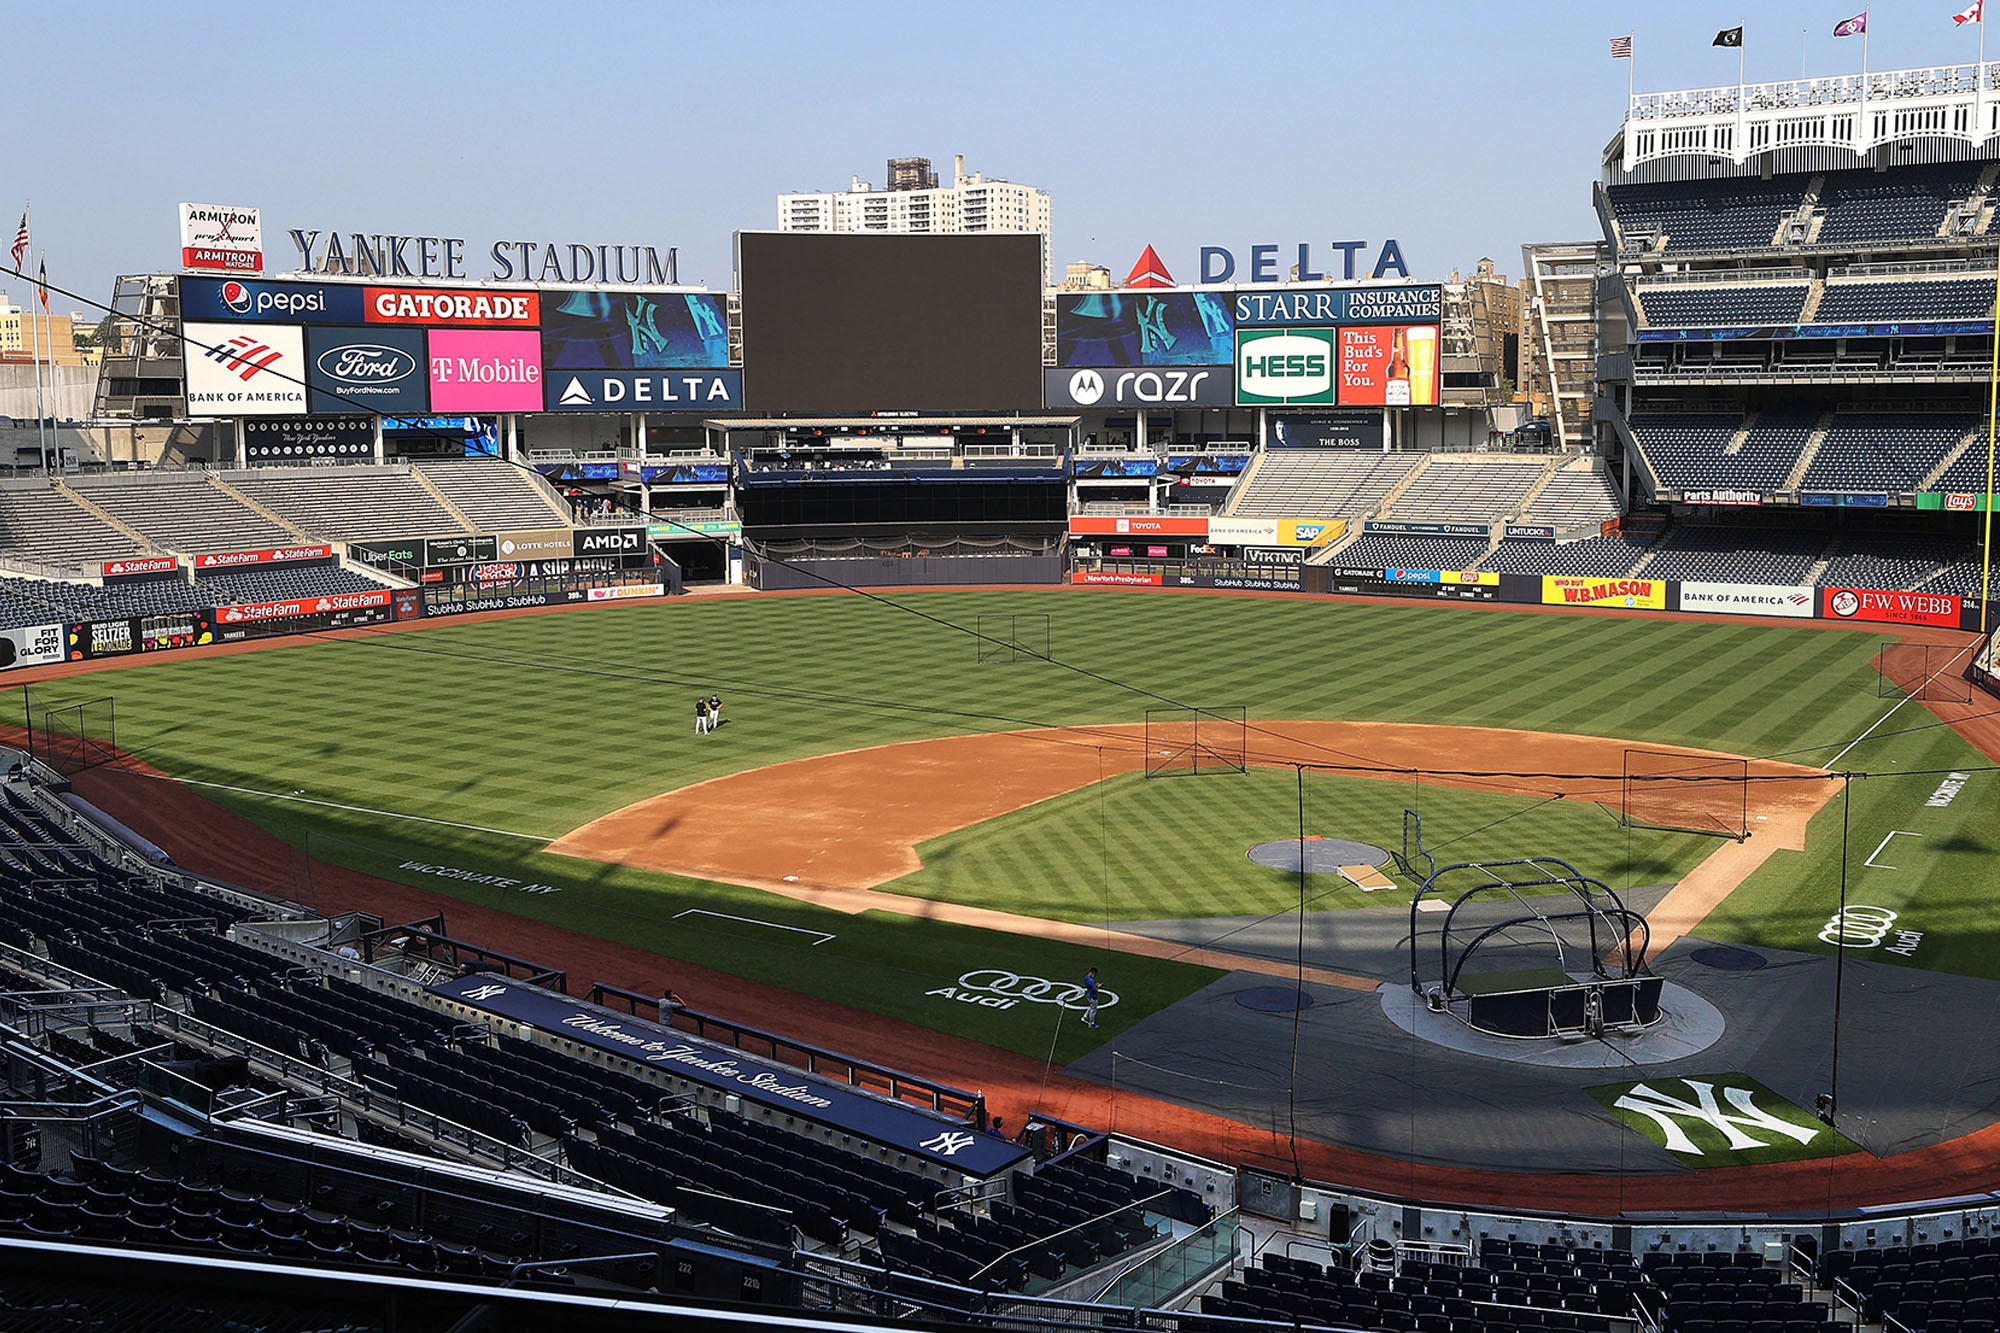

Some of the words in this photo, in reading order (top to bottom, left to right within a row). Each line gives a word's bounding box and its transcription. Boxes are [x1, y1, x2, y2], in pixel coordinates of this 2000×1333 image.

[189, 210, 256, 225] ARMITRON
[195, 251, 255, 262] ARMITRON
[288, 228, 467, 279] YANKEE
[491, 240, 680, 285] STADIUM
[1200, 239, 1409, 285] DELTA
[257, 289, 326, 315] pepsi
[1349, 289, 1440, 305] INSURANCE
[375, 293, 530, 319] GATORADE
[1236, 294, 1338, 321] STARR
[1348, 303, 1440, 319] COMPANIES
[1343, 331, 1377, 344] This
[1344, 345, 1383, 358] Bud's
[334, 349, 399, 378] Ford
[457, 357, 540, 383] Mobile
[1246, 355, 1325, 377] HESS
[1343, 359, 1369, 372] For
[1343, 373, 1375, 386] You.
[336, 386, 401, 395] BuyFordNow.com
[603, 377, 731, 402] DELTA
[1116, 371, 1209, 402] razr
[189, 392, 225, 402] BANK
[227, 392, 244, 402] OF
[247, 392, 303, 402] AMERICA
[1319, 438, 1336, 446] THE
[1338, 438, 1360, 446] BOSS
[1684, 490, 1711, 500] Parts
[1712, 489, 1761, 502] Authority
[1296, 527, 1318, 538] SAP
[1379, 523, 1407, 531] FANDUEL
[1451, 525, 1480, 533] FANDUEL
[583, 535, 623, 550] AMD
[1190, 544, 1216, 554] FedEx
[363, 551, 388, 562] Uber
[389, 550, 413, 560] Eats
[1247, 549, 1301, 563] VIKING
[1343, 569, 1374, 577] GATORADE
[1407, 571, 1431, 580] pepsi
[1214, 578, 1243, 587] StubHub
[1244, 579, 1272, 588] StubHub
[1273, 580, 1301, 590] StubHub
[1571, 579, 1584, 587] BUT
[466, 598, 504, 612] StubHub
[506, 594, 546, 609] StubHub
[1684, 593, 1714, 602] BANK
[1716, 594, 1731, 602] OF
[1733, 595, 1784, 605] AMERICA
[1862, 592, 1894, 611] F.W.
[1898, 595, 1952, 615] WEBB
[1962, 599, 1975, 609] 314
[427, 601, 463, 616] StubHub
[1885, 611, 1907, 620] SINCE
[1911, 613, 1927, 621] 1866
[108, 620, 129, 628] LIGHT
[41, 628, 59, 637] FIT
[92, 628, 131, 642] SELTZER
[223, 631, 246, 639] YANKEES
[35, 637, 59, 646] FOR
[91, 639, 133, 652] LEMONADE
[20, 646, 59, 657] GLORY
[398, 860, 522, 889] VACCINATE
[518, 883, 563, 896] NY
[1885, 929, 1924, 957] Audi
[925, 987, 1020, 1011] Audi
[561, 1013, 645, 1047] Welcome
[645, 1040, 664, 1053] to
[645, 1043, 739, 1078] Yankee
[737, 1072, 833, 1109] Stadium
[678, 1262, 692, 1274] 222
